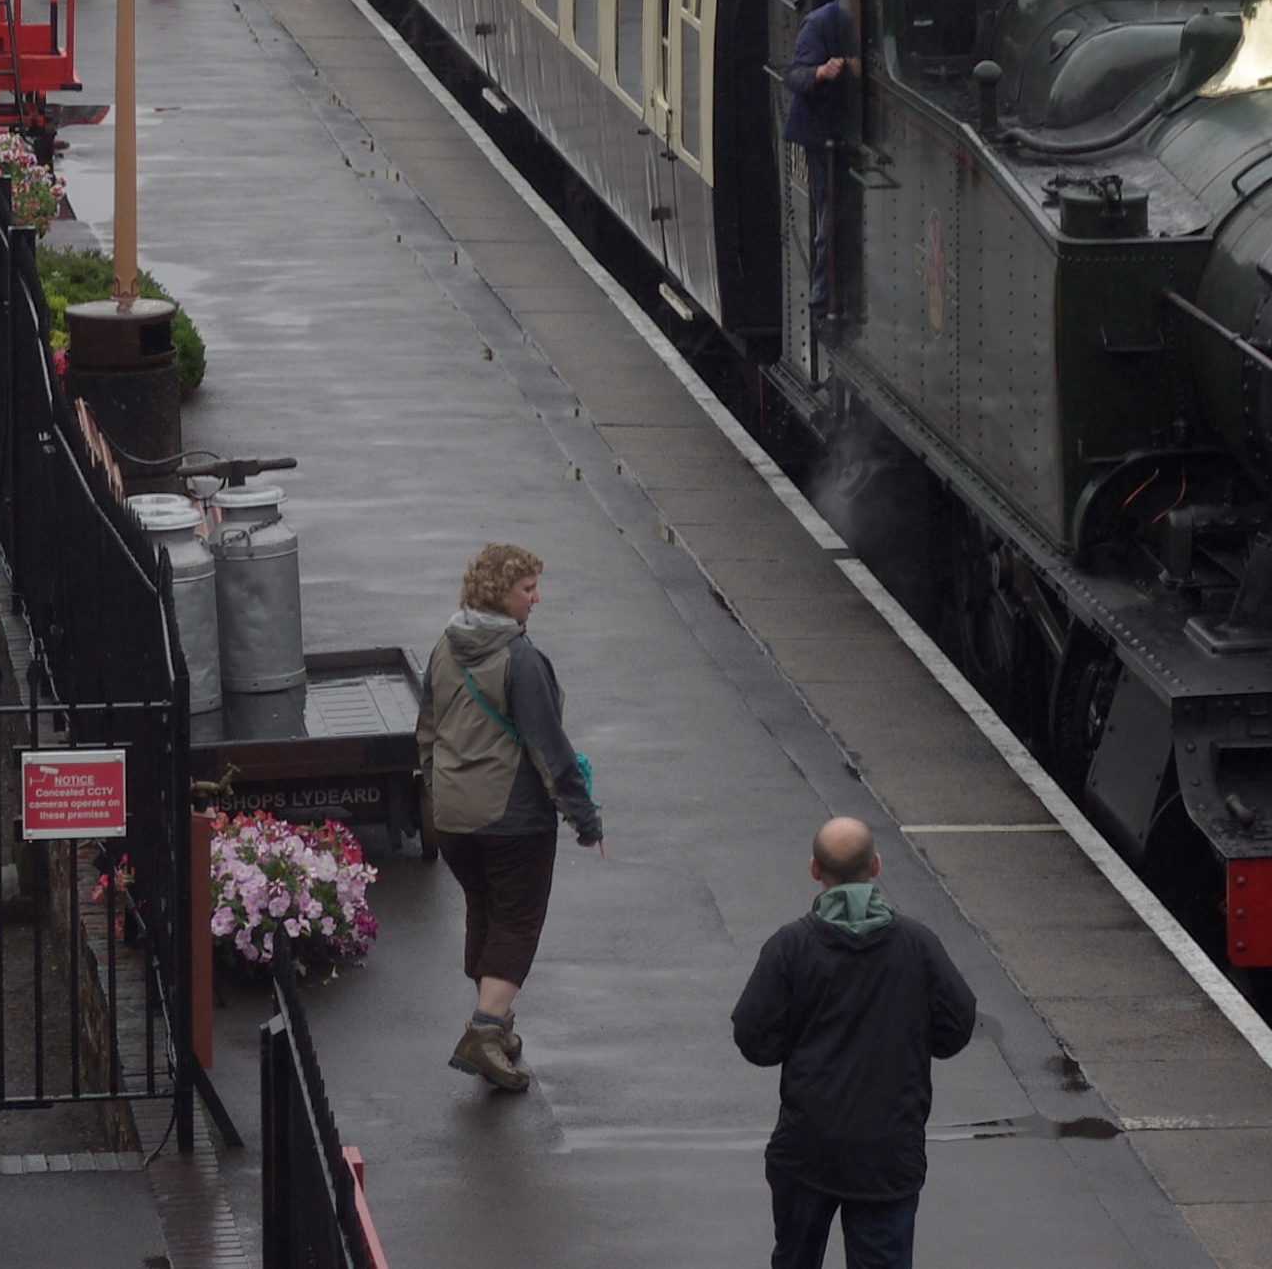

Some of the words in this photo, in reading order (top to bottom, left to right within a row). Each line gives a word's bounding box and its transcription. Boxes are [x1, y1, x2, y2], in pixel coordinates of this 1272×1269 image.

[54, 775, 95, 785] NOTICE
[35, 787, 85, 798] Concealed
[86, 786, 114, 796] CCTV
[292, 787, 381, 807] LYDEARD
[29, 800, 69, 809] cameras
[70, 798, 106, 810] operate
[107, 799, 121, 807] on
[39, 810, 65, 820] these
[67, 809, 110, 822] premises
